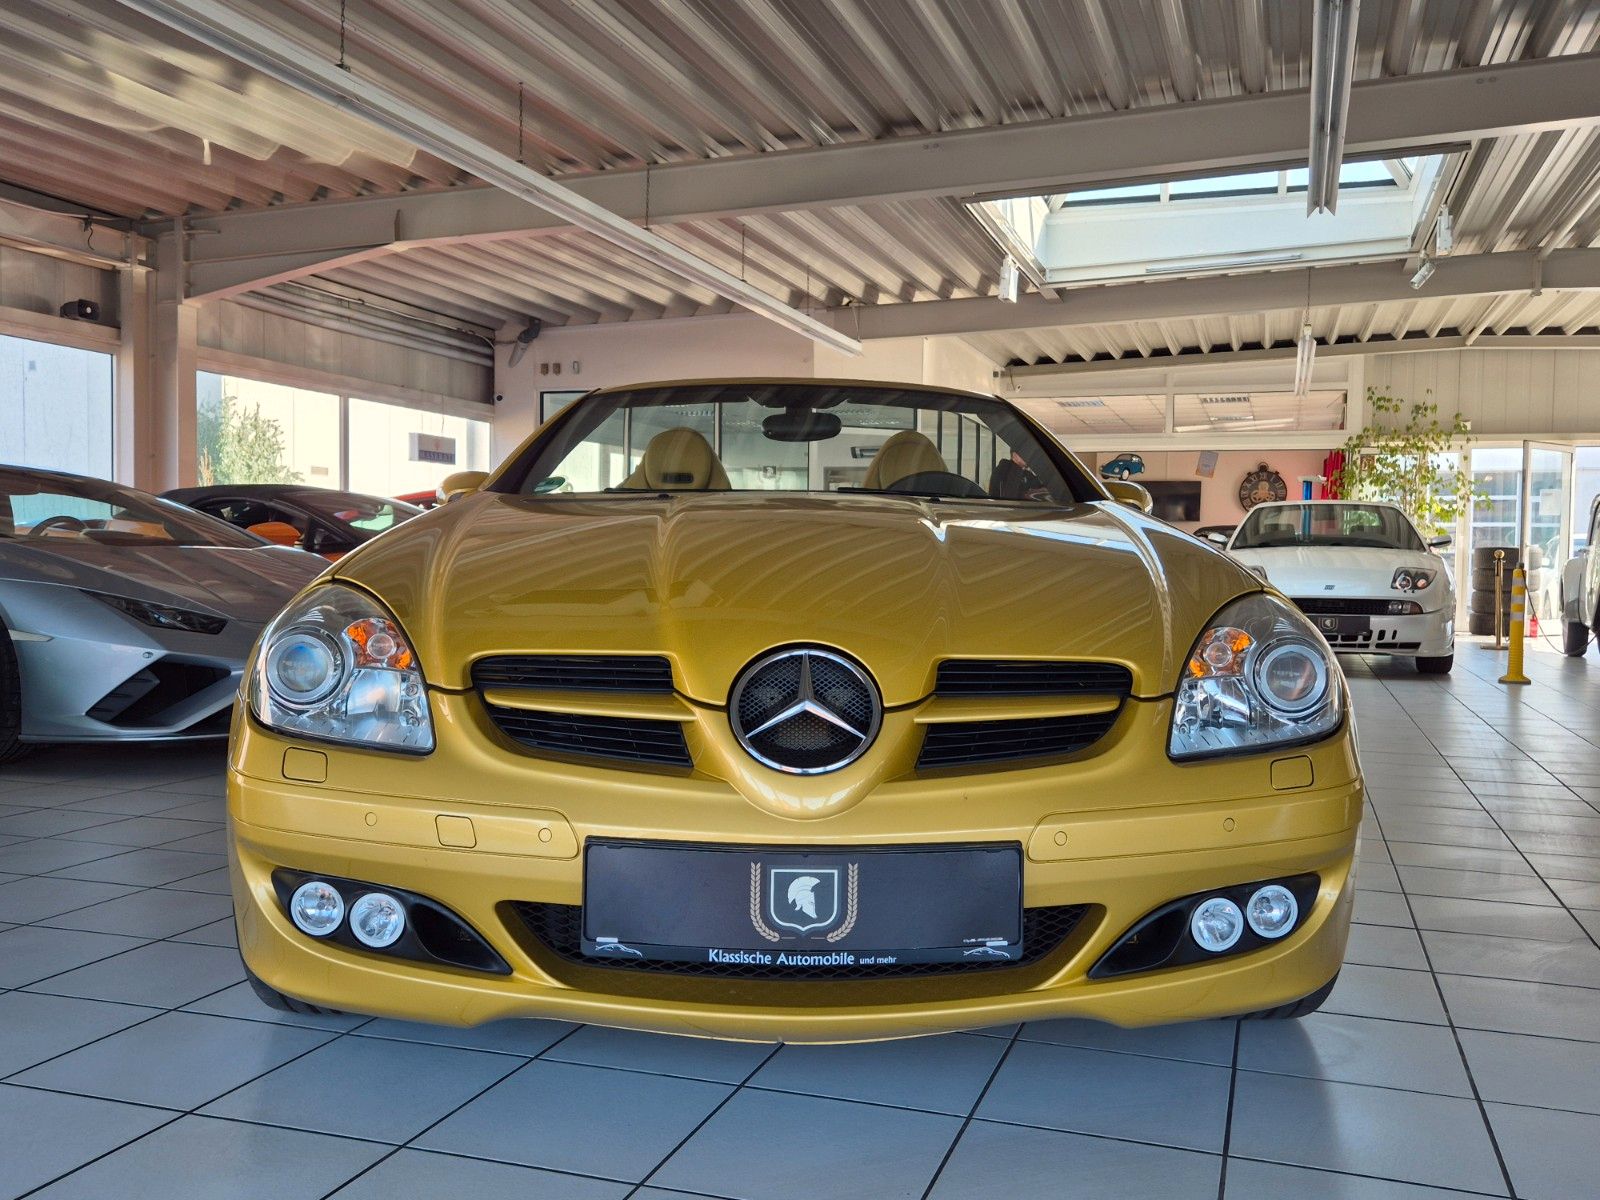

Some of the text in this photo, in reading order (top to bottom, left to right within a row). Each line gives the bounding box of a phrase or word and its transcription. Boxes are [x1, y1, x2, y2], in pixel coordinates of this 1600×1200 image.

[708, 949, 897, 966] Klassische Automobile und mehr
